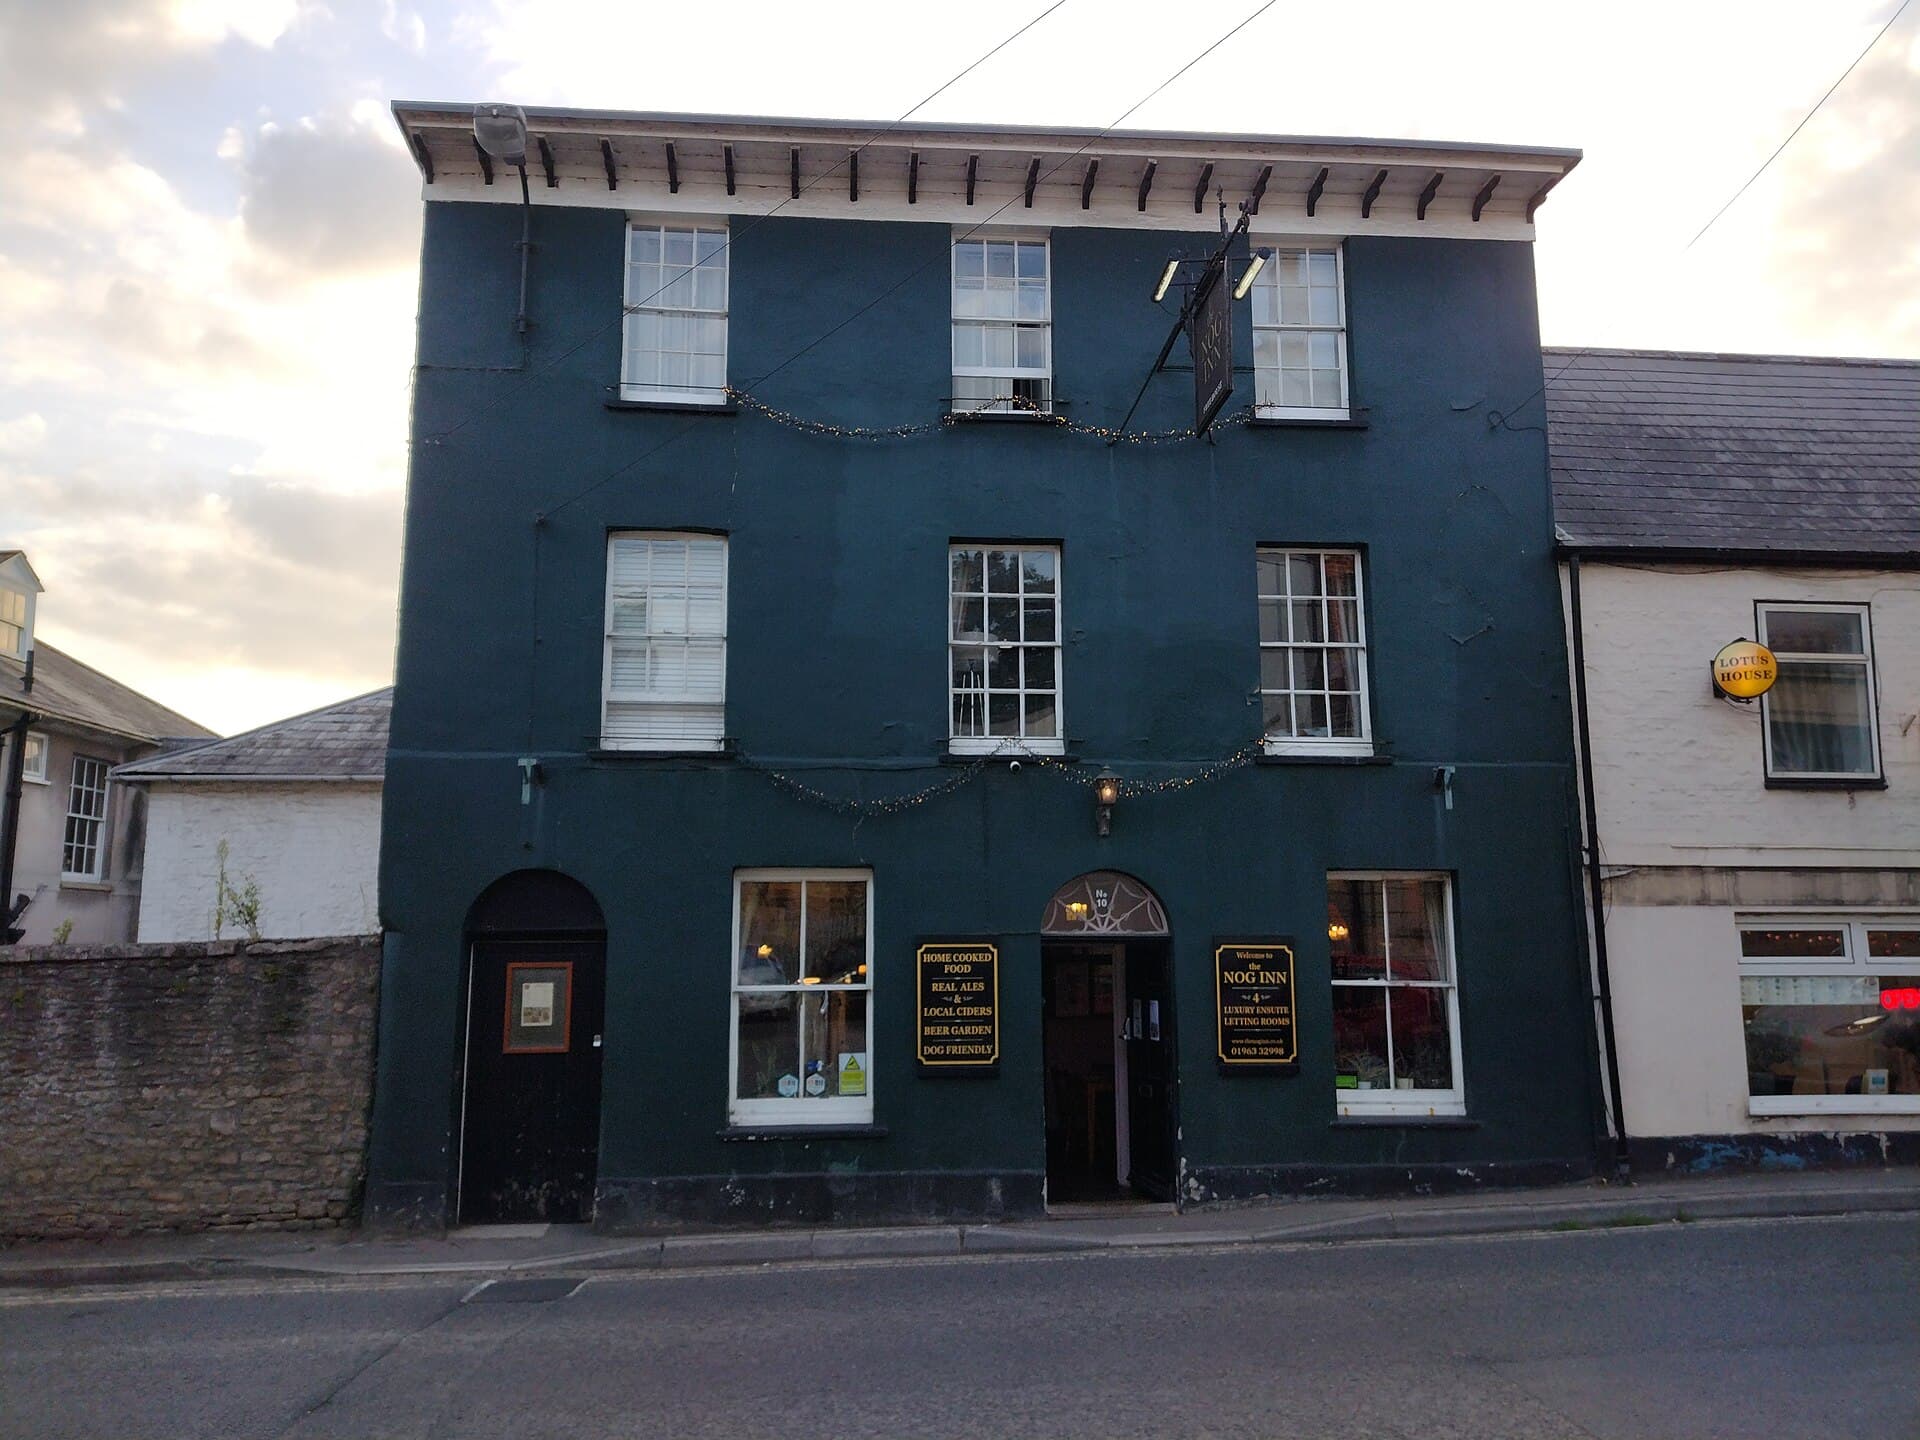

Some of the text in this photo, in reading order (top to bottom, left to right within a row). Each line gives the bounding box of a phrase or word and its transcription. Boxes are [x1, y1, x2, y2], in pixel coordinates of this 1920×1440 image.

[1720, 655, 1769, 668] LOTUS
[1721, 670, 1773, 682] HOUSE
[1096, 898, 1108, 907] 10
[923, 953, 992, 962] HOME COOKED
[1236, 951, 1265, 959] Welcome
[944, 964, 972, 974] FOOD
[1249, 962, 1261, 970] the
[1224, 971, 1287, 984] NOG INN
[932, 982, 984, 992] REAL ALES
[953, 994, 962, 1004] &
[1252, 992, 1260, 1003] 4
[923, 1007, 993, 1017] LOCAL CIDERS
[1224, 1006, 1289, 1014] LUXURY ENSUITE
[1224, 1017, 1290, 1025] LETTING ROOMS
[924, 1025, 992, 1035] BEER GARDEN
[923, 1045, 993, 1055] DOG FRIENDLY
[1231, 1047, 1284, 1055] 01963 32998
